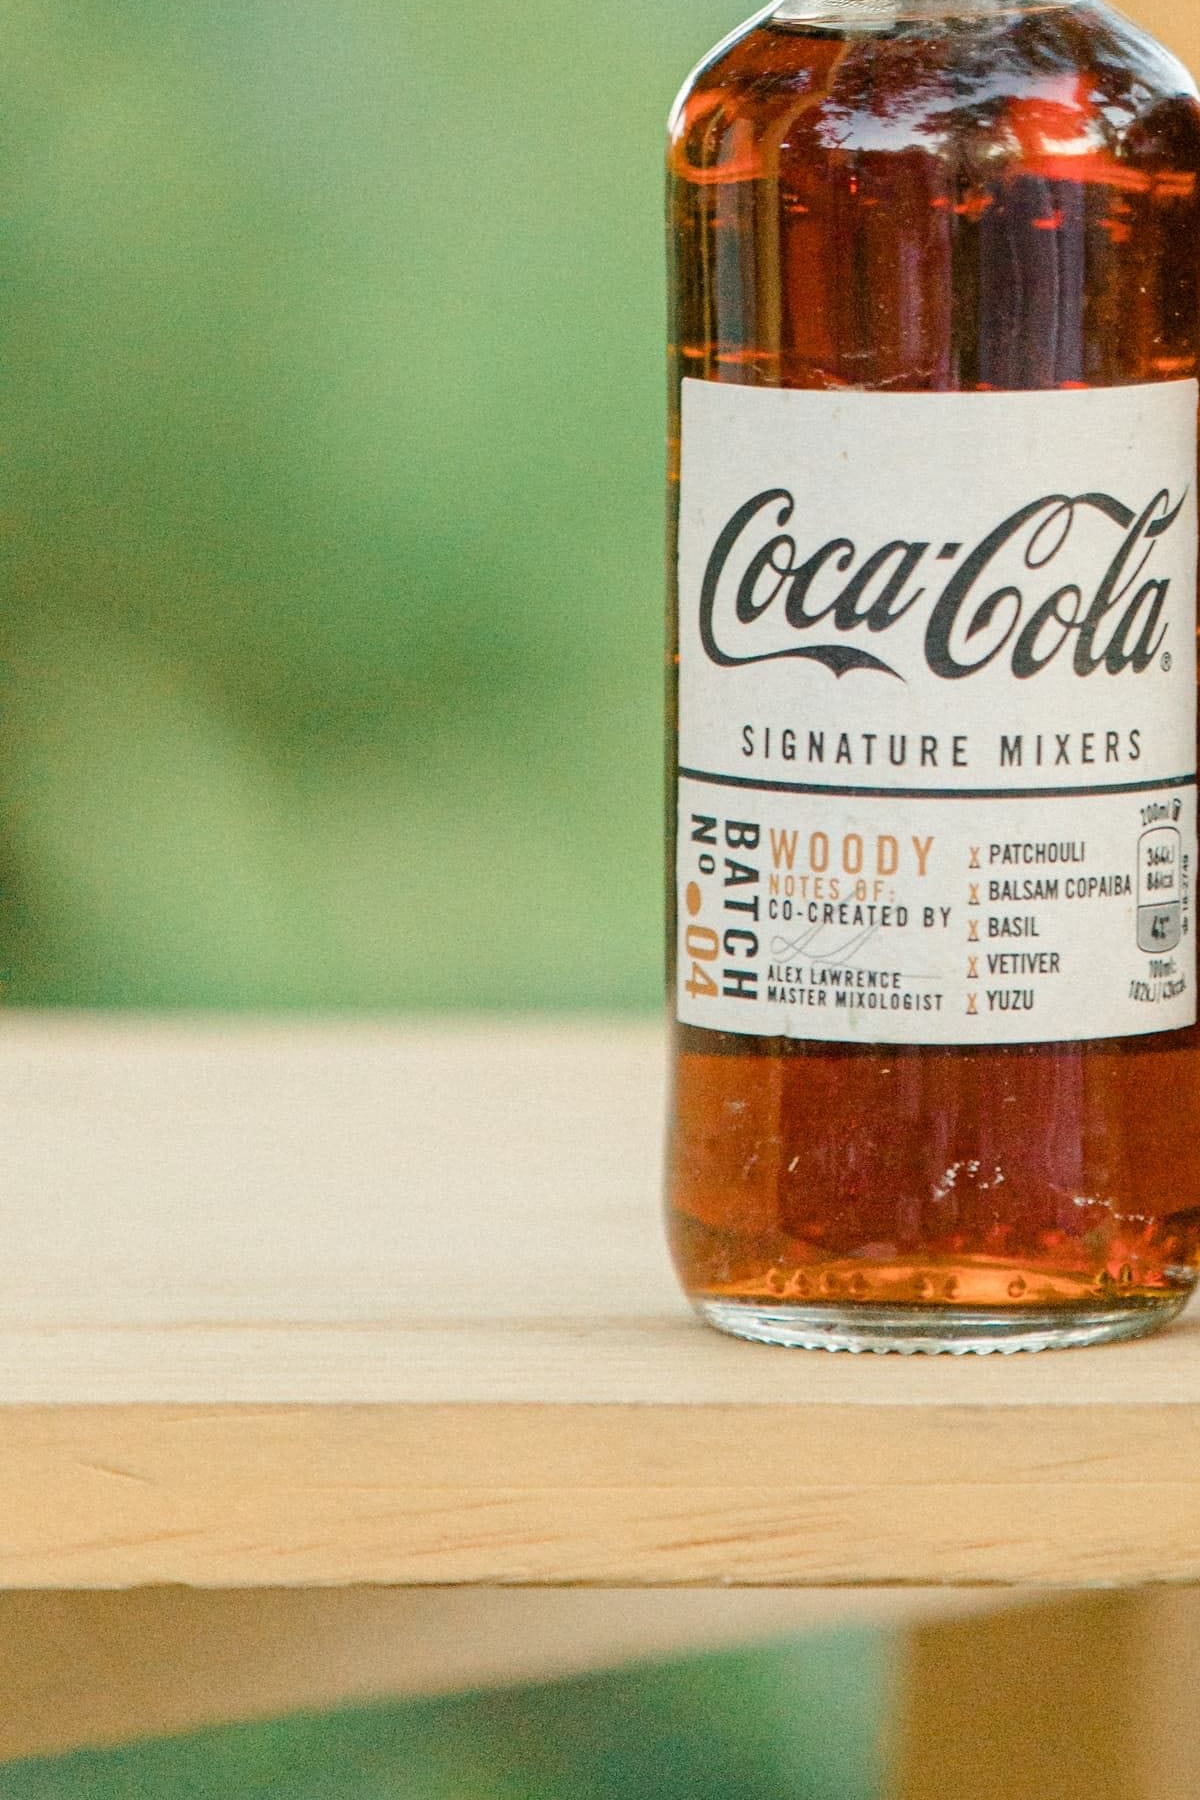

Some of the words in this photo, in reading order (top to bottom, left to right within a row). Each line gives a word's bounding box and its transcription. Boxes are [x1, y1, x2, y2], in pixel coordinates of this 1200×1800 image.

[741, 724, 969, 768] SIGNATURE
[999, 728, 1143, 768] MIXERS
[769, 828, 935, 877] WOODY
[988, 841, 1086, 865] PATCHOULI
[768, 875, 841, 900] NOTES
[854, 879, 896, 903] OF:
[988, 878, 1059, 902] BALSAM
[1065, 874, 1133, 899] COPAIBA
[722, 819, 760, 1001] BATCH
[768, 899, 909, 927] CO-CREATED
[923, 906, 952, 928] BY
[987, 916, 1040, 938] BASIL
[767, 964, 803, 984] ALEX
[810, 968, 902, 990] LAWRENCE
[987, 952, 1061, 975] VETIVER
[767, 986, 827, 1007] MASTER
[835, 992, 944, 1012] MIXOLOGIST
[986, 989, 1035, 1011] YUZU
